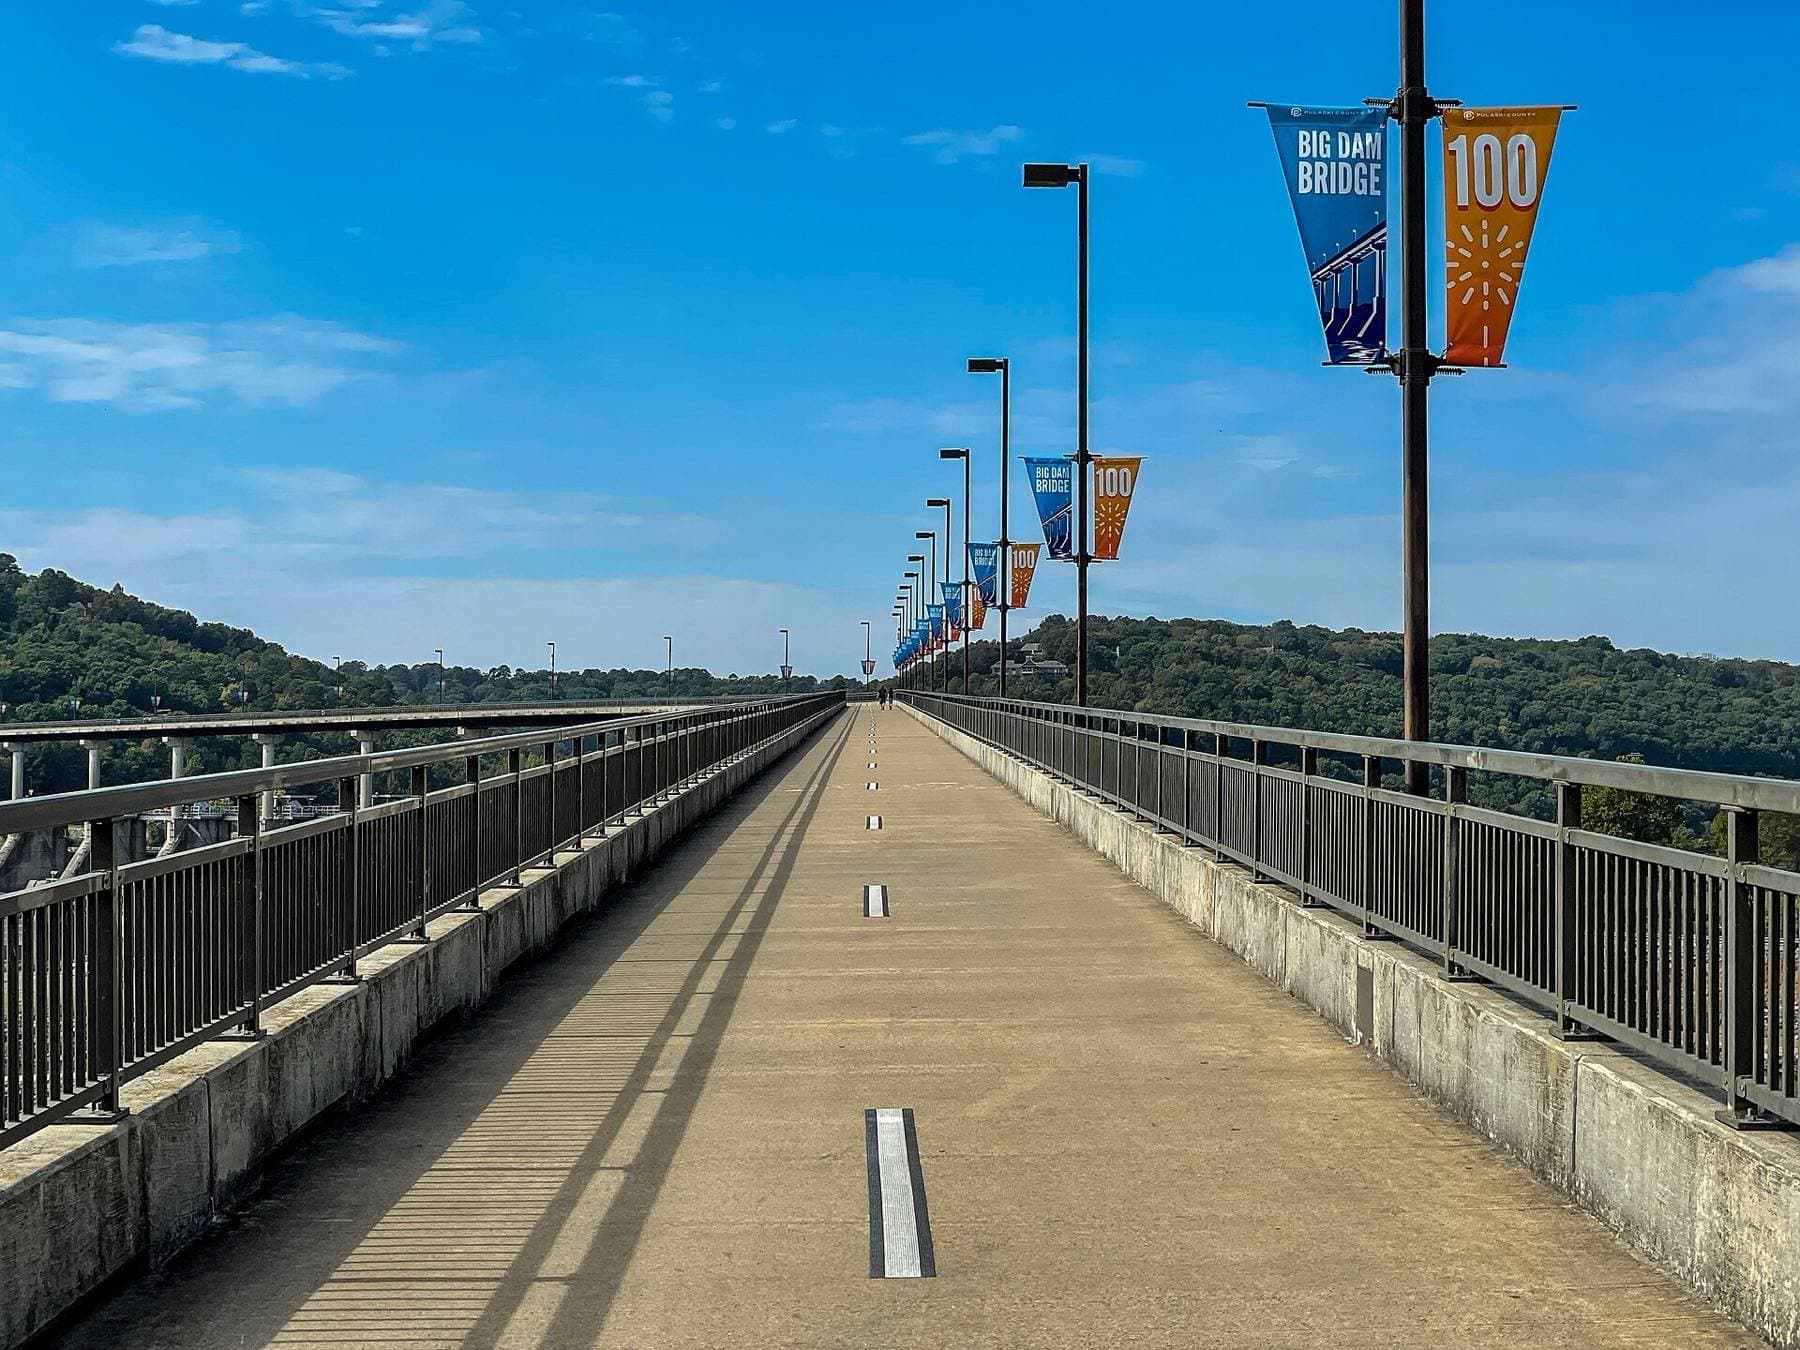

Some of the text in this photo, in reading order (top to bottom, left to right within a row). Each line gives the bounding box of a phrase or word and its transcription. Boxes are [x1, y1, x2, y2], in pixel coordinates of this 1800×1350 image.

[1298, 130, 1382, 160] BIG DAM
[1298, 161, 1381, 196] BRIDGE
[1448, 133, 1537, 208] 100
[1036, 467, 1070, 479] BIG DAM
[1036, 479, 1070, 493] BRIDGE
[1096, 467, 1132, 497] 100
[1012, 550, 1035, 569] 100
